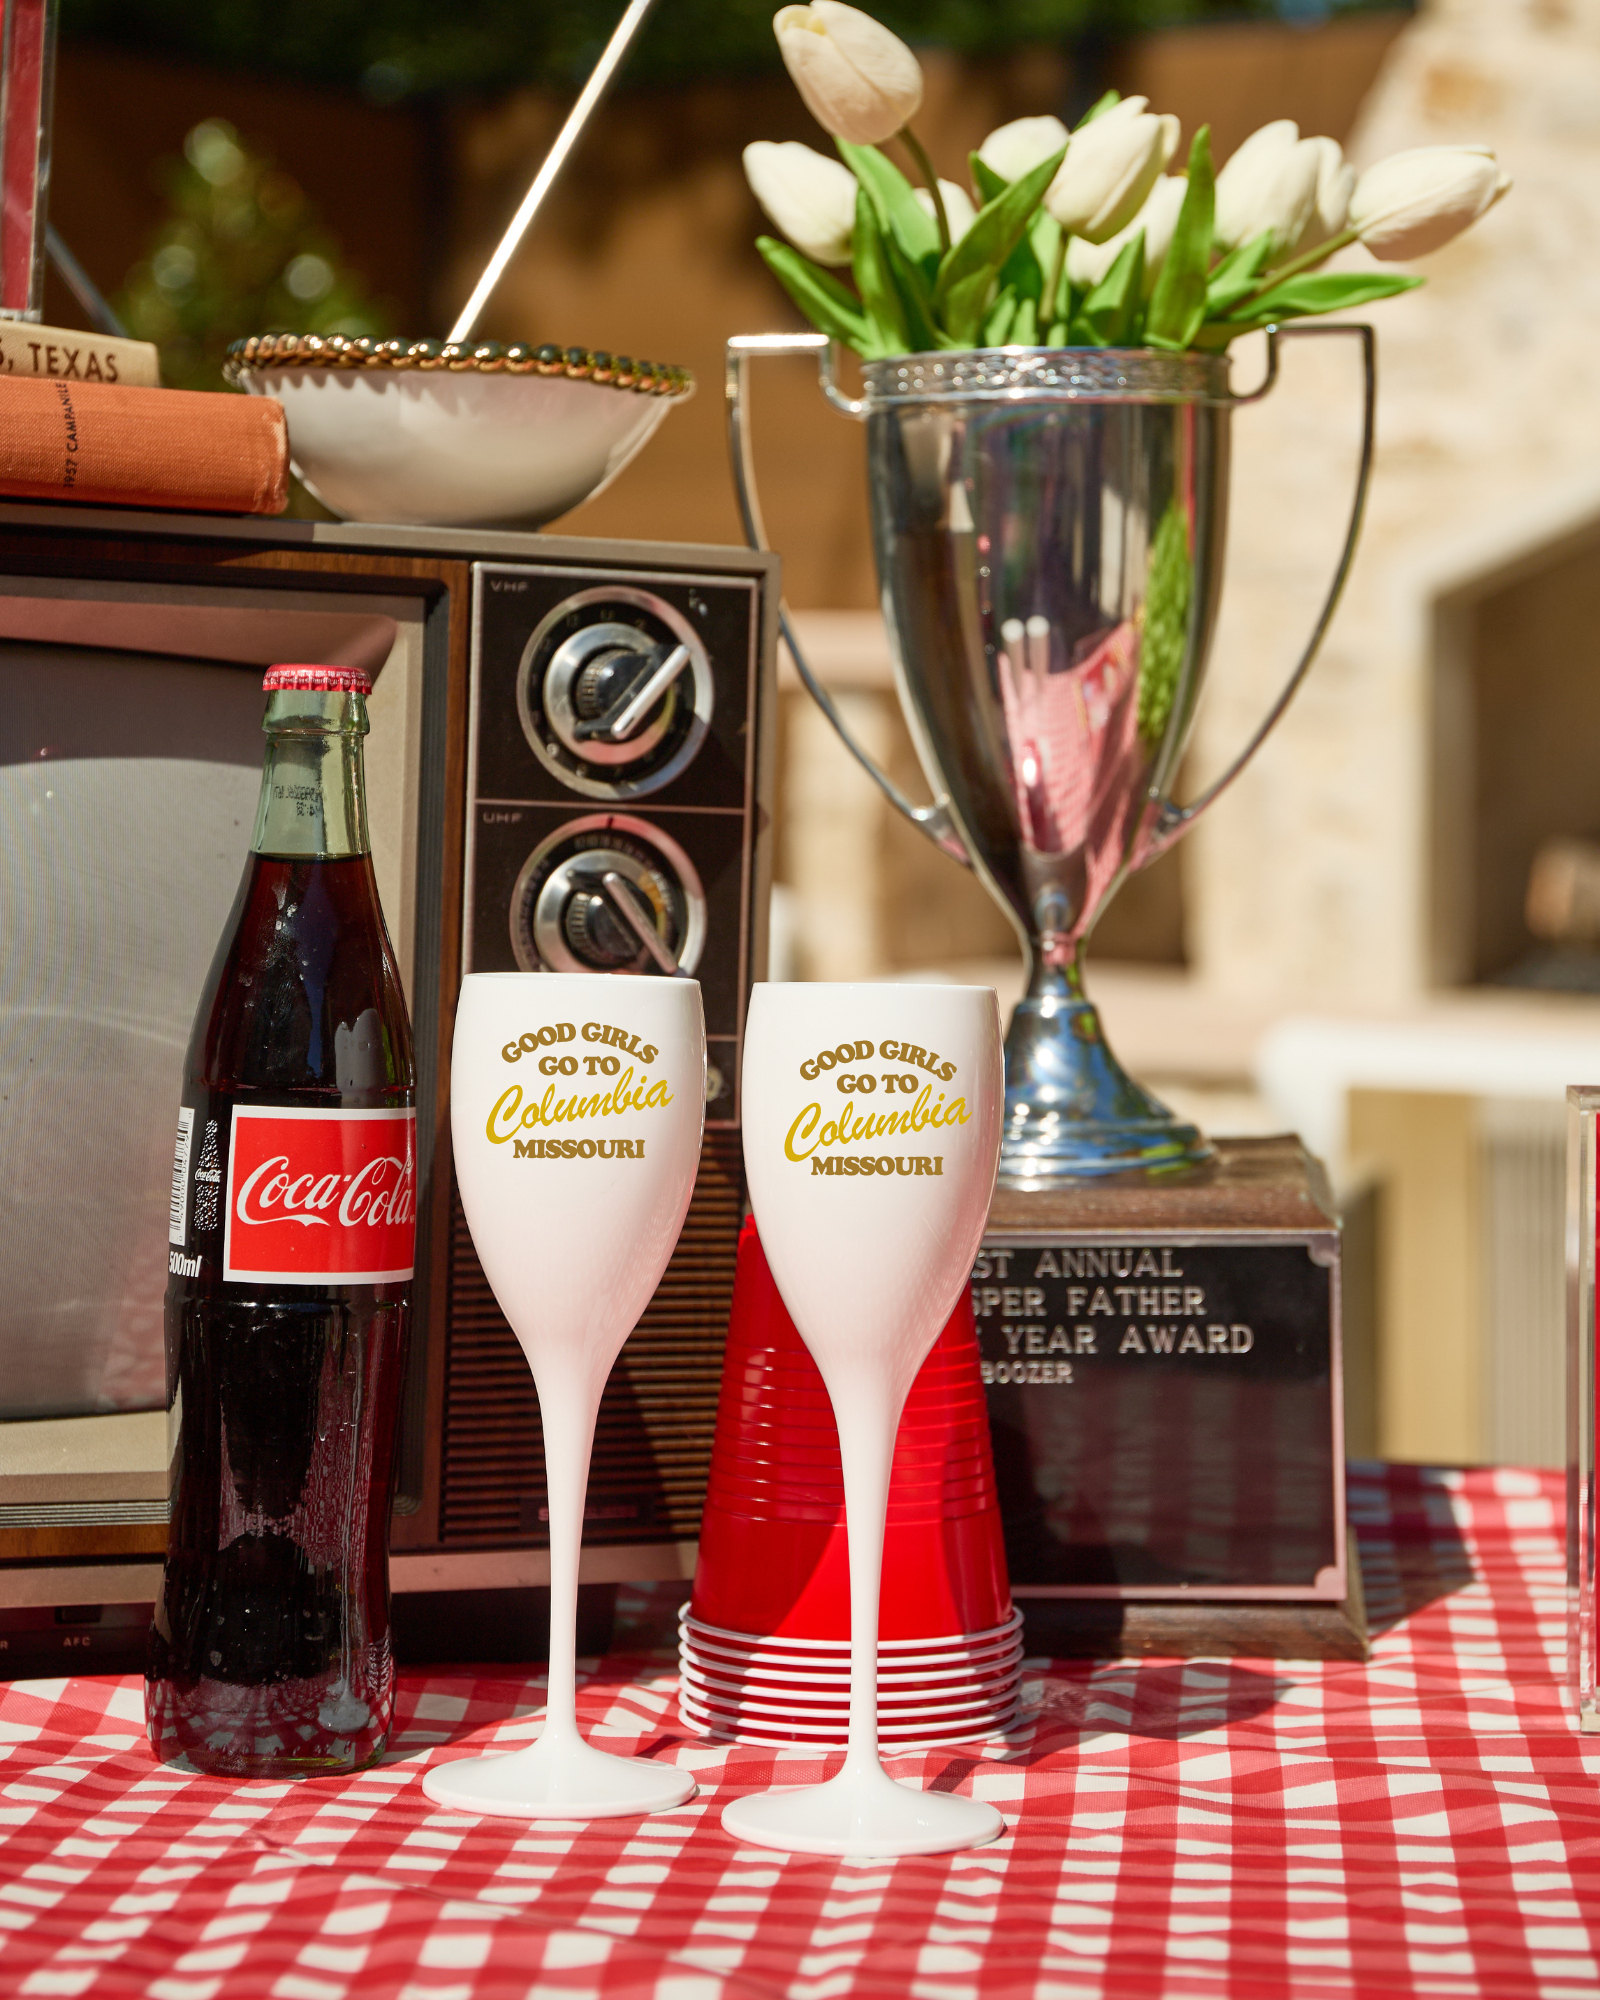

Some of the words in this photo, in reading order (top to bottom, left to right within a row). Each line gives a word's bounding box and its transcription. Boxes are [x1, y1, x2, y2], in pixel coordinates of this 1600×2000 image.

[27, 343, 118, 383] TEXAS
[56, 383, 78, 453] CAMPANILE
[63, 458, 77, 487] 1957
[490, 580, 529, 592] VHF
[483, 812, 523, 824] UHF
[502, 1022, 577, 1064] GOOD
[581, 1022, 659, 1064] GIRLS
[538, 1056, 579, 1076] GO
[583, 1056, 621, 1076] TO
[799, 1040, 875, 1081] GOOD
[879, 1039, 958, 1082] GIRLS
[836, 1074, 877, 1094] GO
[880, 1074, 919, 1094] TO
[485, 1066, 674, 1145] Columbia
[784, 1083, 973, 1163] Columbia
[512, 1139, 646, 1159] MISSOURI
[810, 1156, 944, 1176] MISSOURI
[236, 1155, 414, 1227] Coca-Cola
[169, 1251, 202, 1278] 500ml
[1034, 1248, 1184, 1279] ANNUAL
[1066, 1286, 1208, 1316] FATHER
[1000, 1324, 1099, 1355] YEAR
[1119, 1324, 1255, 1355] AWARD
[63, 1636, 92, 1647] AFC
